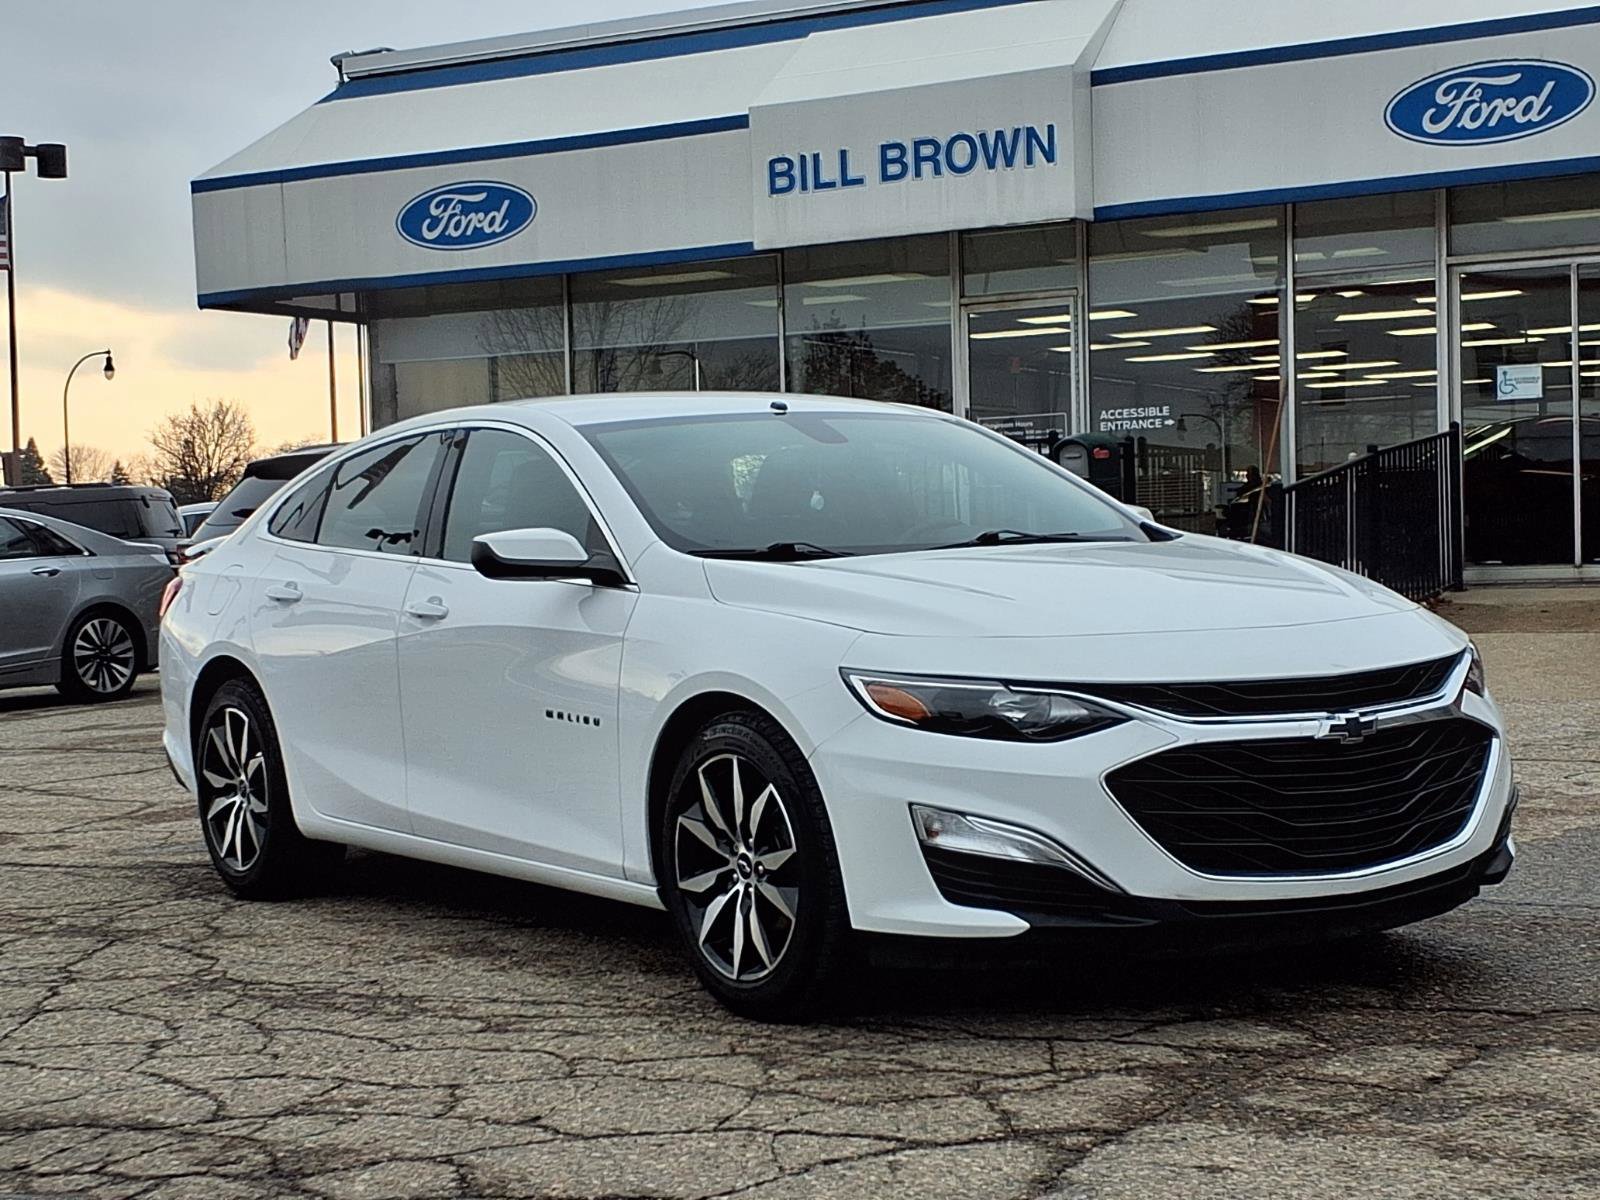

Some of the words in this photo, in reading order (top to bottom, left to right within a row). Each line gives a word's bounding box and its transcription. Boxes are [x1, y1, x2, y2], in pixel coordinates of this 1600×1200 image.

[1421, 72, 1556, 134] Ford
[768, 149, 866, 197] BILL
[879, 123, 1057, 184] BROWN
[421, 191, 511, 240] Ford
[1099, 405, 1170, 420] ACCESSIBLE
[1100, 418, 1163, 432] ENTRANCE
